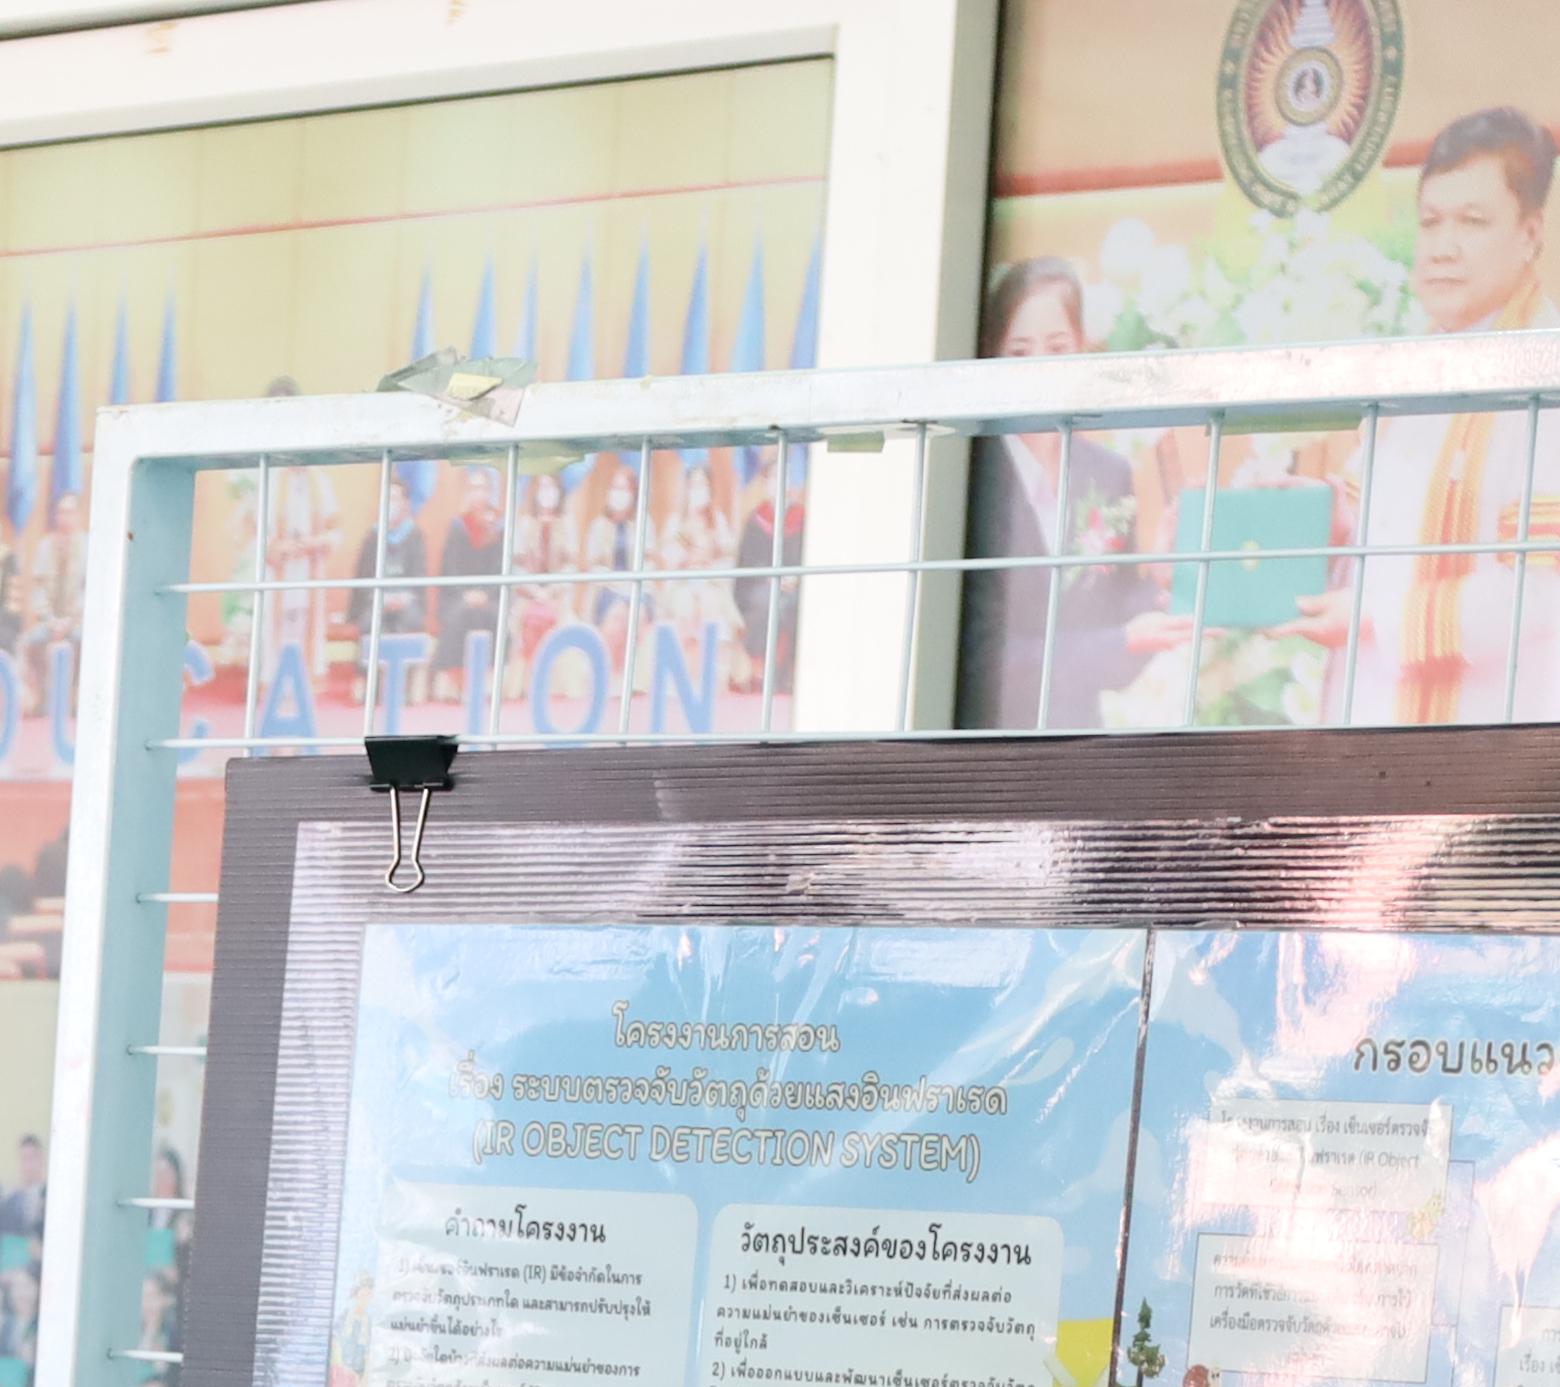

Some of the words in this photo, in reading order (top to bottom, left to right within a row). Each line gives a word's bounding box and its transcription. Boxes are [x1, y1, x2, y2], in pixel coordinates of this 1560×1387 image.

[612, 1001, 840, 1052] โครงงานการสอน
[448, 1049, 504, 1099] เรื่อง
[512, 1064, 1007, 1122] ระบบตรวจจับวัตถุด้วยแสงอินฟราเรด
[1221, 1110, 1312, 1134] โงงานการสอน
[1344, 1118, 1429, 1137] เซ็นเซอร์ตรวจจั
[471, 1119, 514, 1165] (IR
[522, 1121, 643, 1162] OBJECT
[648, 1125, 836, 1168] DETECTION
[839, 1131, 982, 1183] SYSTEM)
[1378, 1153, 1420, 1170] Object
[445, 1203, 607, 1244] คำถามโครงงาน
[740, 1221, 1032, 1267] วัตถุประสงค์ของโครงงาน
[523, 1264, 547, 1284] (IR)
[549, 1265, 643, 1286] มีข้อจำกัดในการ
[722, 1273, 737, 1294] 1)
[741, 1270, 1012, 1305] เพื่อทดสอบและวิเคราะห์ปัจจัยที่ส่งผลต่อ
[523, 1296, 651, 1322] และสามารถปรับปรุงให้
[716, 1305, 886, 1327] ความแม่นยำของเซ็นเซอร์
[891, 1312, 918, 1329] เช่น
[923, 1316, 1036, 1342] การตรวจจับวัตถุ
[714, 1330, 768, 1355] ที่อยู่ใกล้
[711, 1361, 726, 1382] 2)
